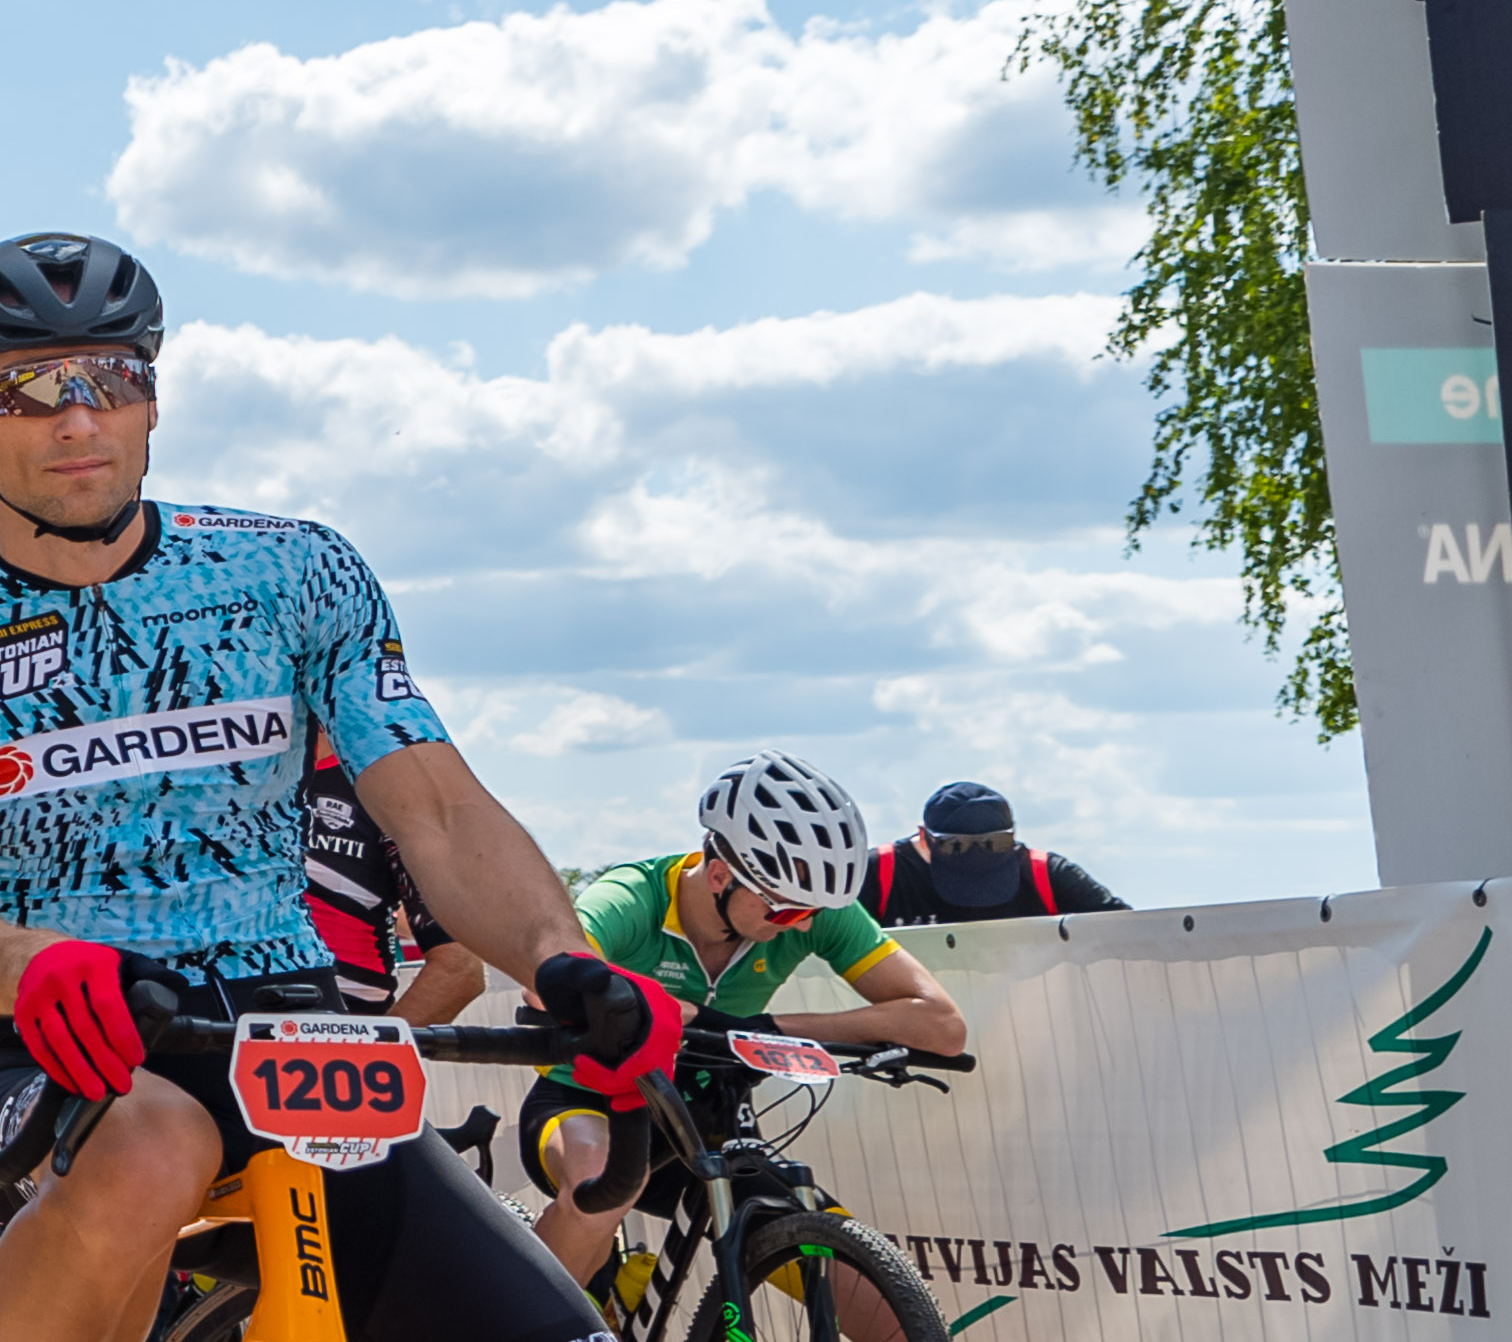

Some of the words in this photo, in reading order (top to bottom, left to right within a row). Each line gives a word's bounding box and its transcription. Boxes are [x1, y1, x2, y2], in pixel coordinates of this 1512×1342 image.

[199, 517, 295, 530] GARDENA
[10, 615, 60, 638] EXPRESS
[42, 712, 289, 780] GARDENA
[300, 1021, 370, 1037] GARDENA
[252, 1059, 407, 1114] 1209
[339, 1141, 371, 1155] CUP
[289, 1187, 329, 1302] BMC
[1093, 1245, 1331, 1305] VALSTS
[1351, 1247, 1492, 1319] MEŽI
